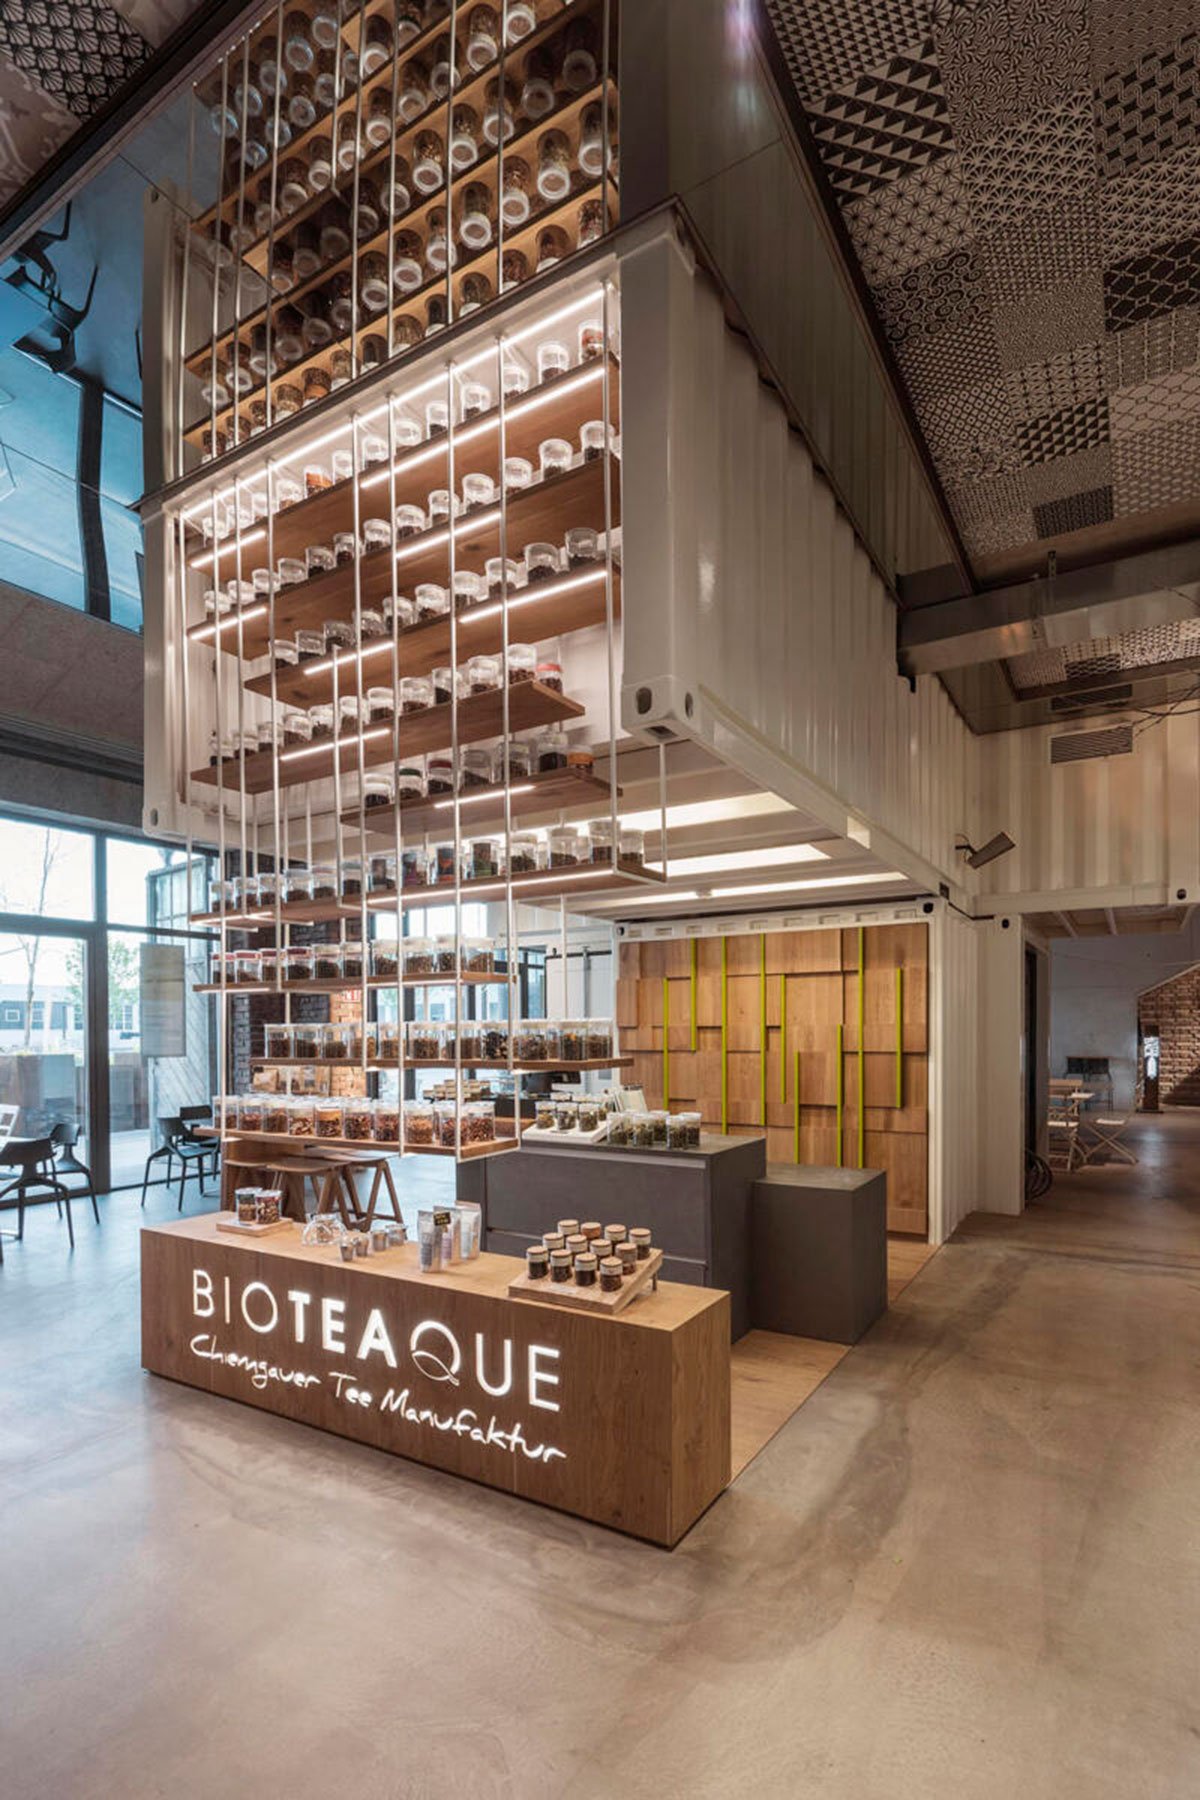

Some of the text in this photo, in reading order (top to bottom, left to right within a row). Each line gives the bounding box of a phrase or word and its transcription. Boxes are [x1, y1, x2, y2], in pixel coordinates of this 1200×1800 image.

[190, 1334, 567, 1463] Chiemgauer Tee Manufaktur
[192, 1269, 560, 1412] BIOTEAQUE
